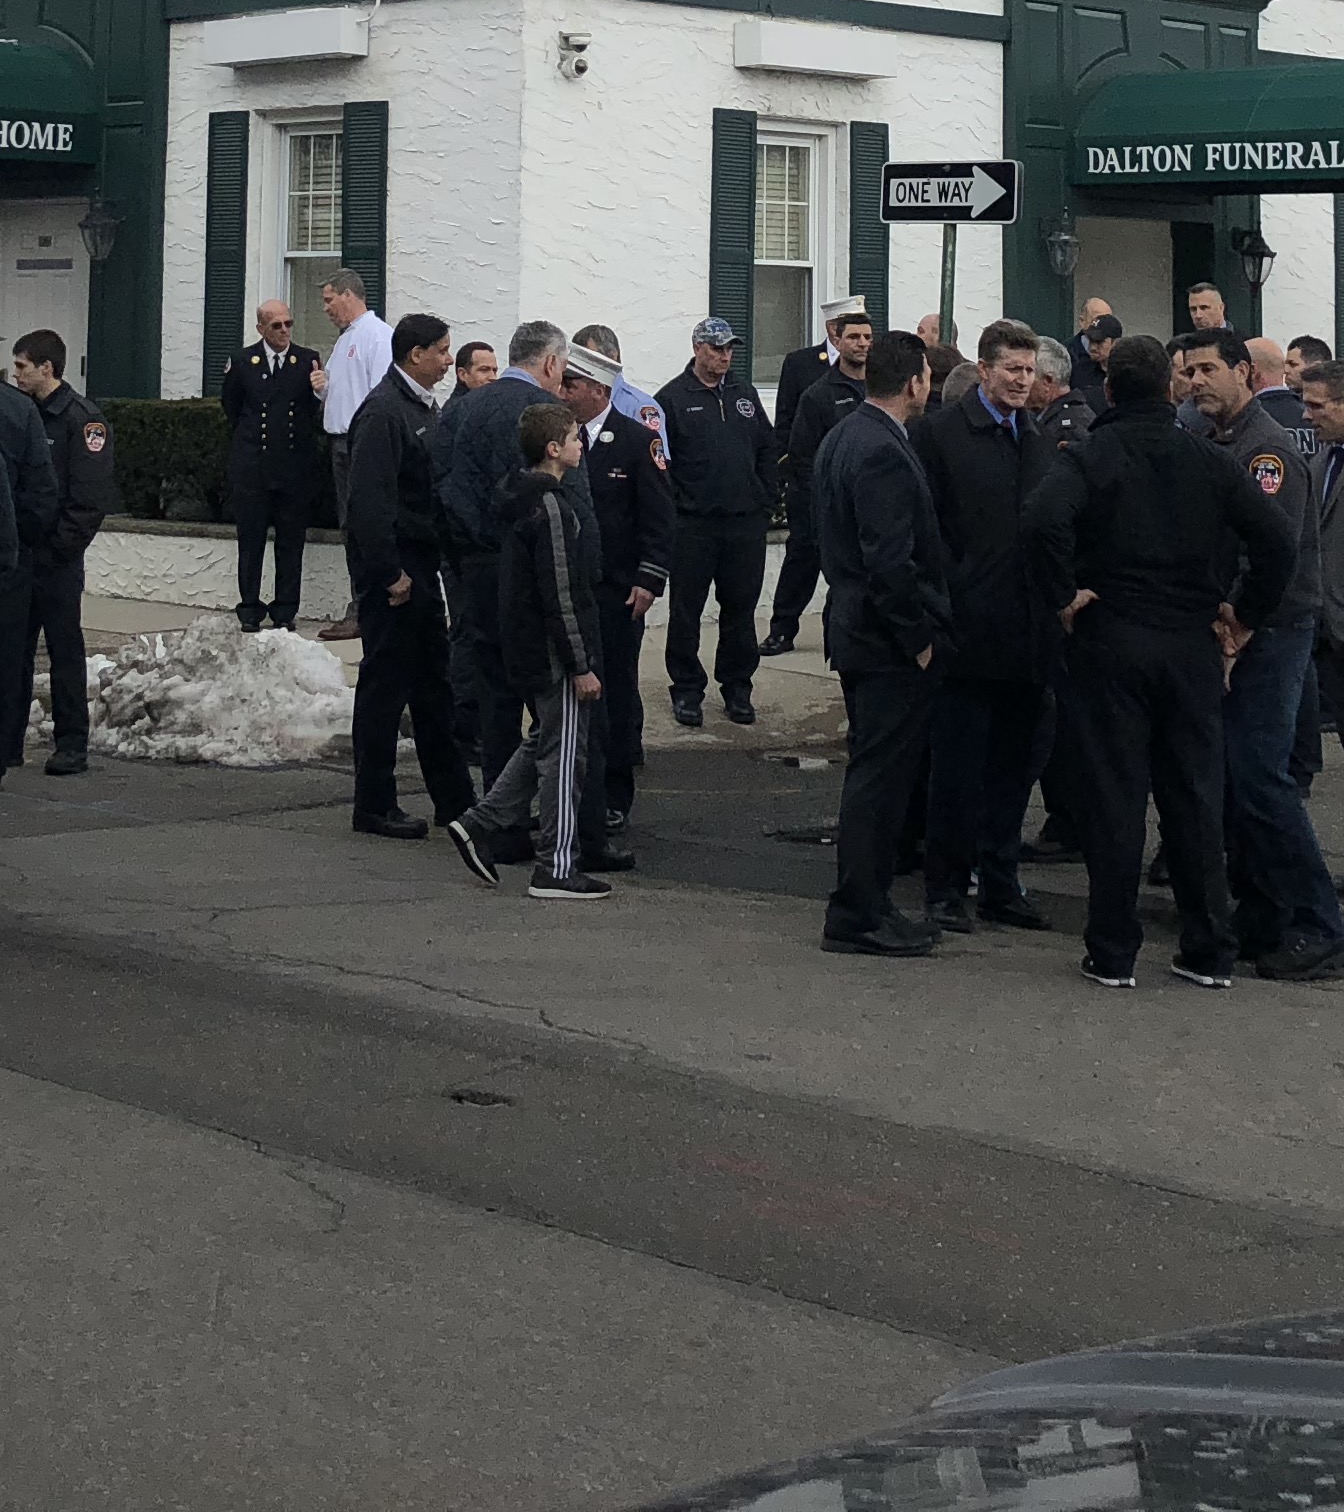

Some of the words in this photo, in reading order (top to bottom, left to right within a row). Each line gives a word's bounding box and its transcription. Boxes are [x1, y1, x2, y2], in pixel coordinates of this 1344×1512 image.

[1087, 144, 1194, 174] DALTON
[895, 181, 932, 204] ONE
[936, 180, 974, 204] WAY
